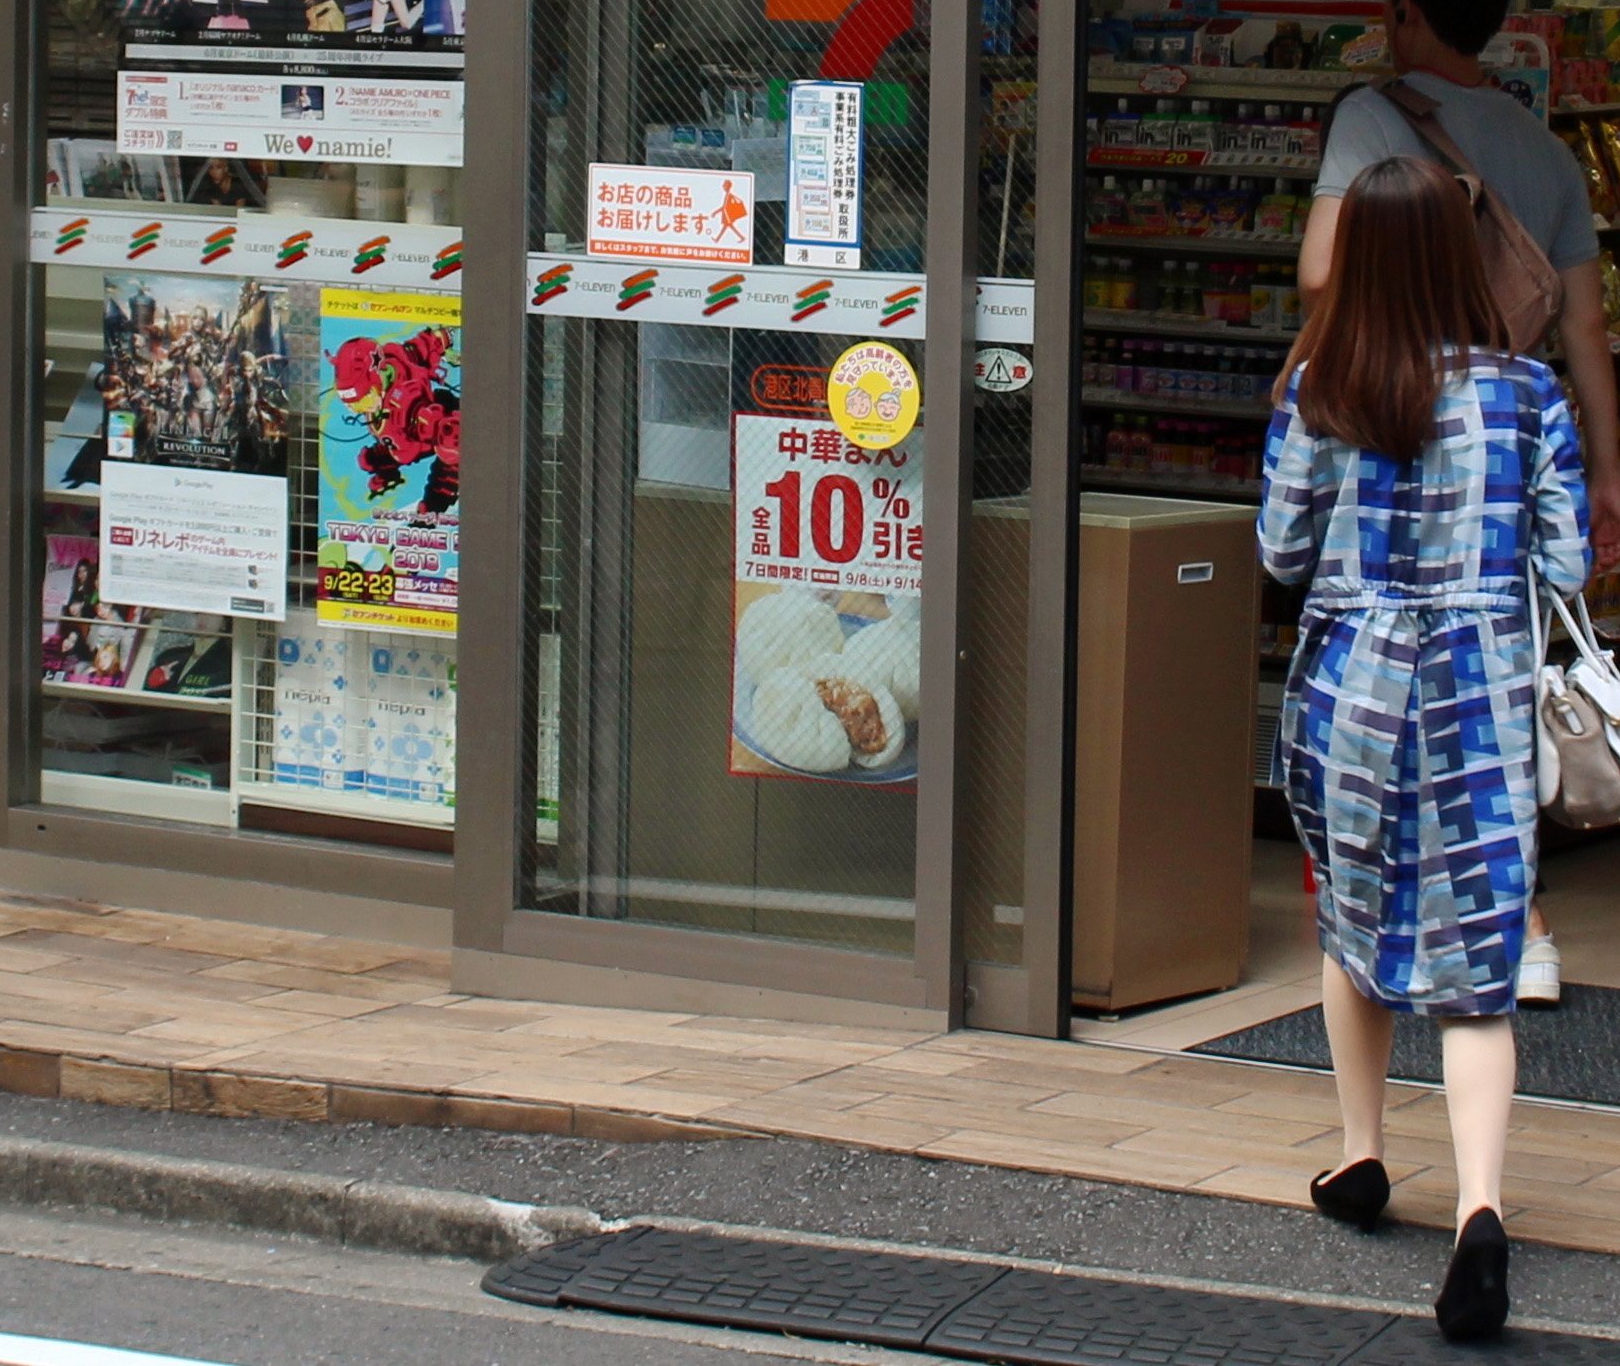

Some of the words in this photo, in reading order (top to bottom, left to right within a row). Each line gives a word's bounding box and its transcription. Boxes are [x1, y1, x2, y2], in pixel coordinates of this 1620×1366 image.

[264, 133, 294, 155] We
[316, 136, 393, 159] namie!
[596, 181, 693, 209] お店の商品
[596, 206, 713, 236] お届けします。
[834, 346, 915, 391] 私たちは高齢者の方を
[162, 441, 227, 456] REVOLUTION
[134, 528, 191, 552] リネレボ
[326, 520, 391, 546] TOKYO
[395, 528, 448, 551] GAME
[750, 506, 771, 556] 全品
[393, 551, 440, 572] 2018
[744, 561, 809, 581] 7日間限定!
[284, 687, 331, 705] nepia
[378, 701, 426, 717] nepia
